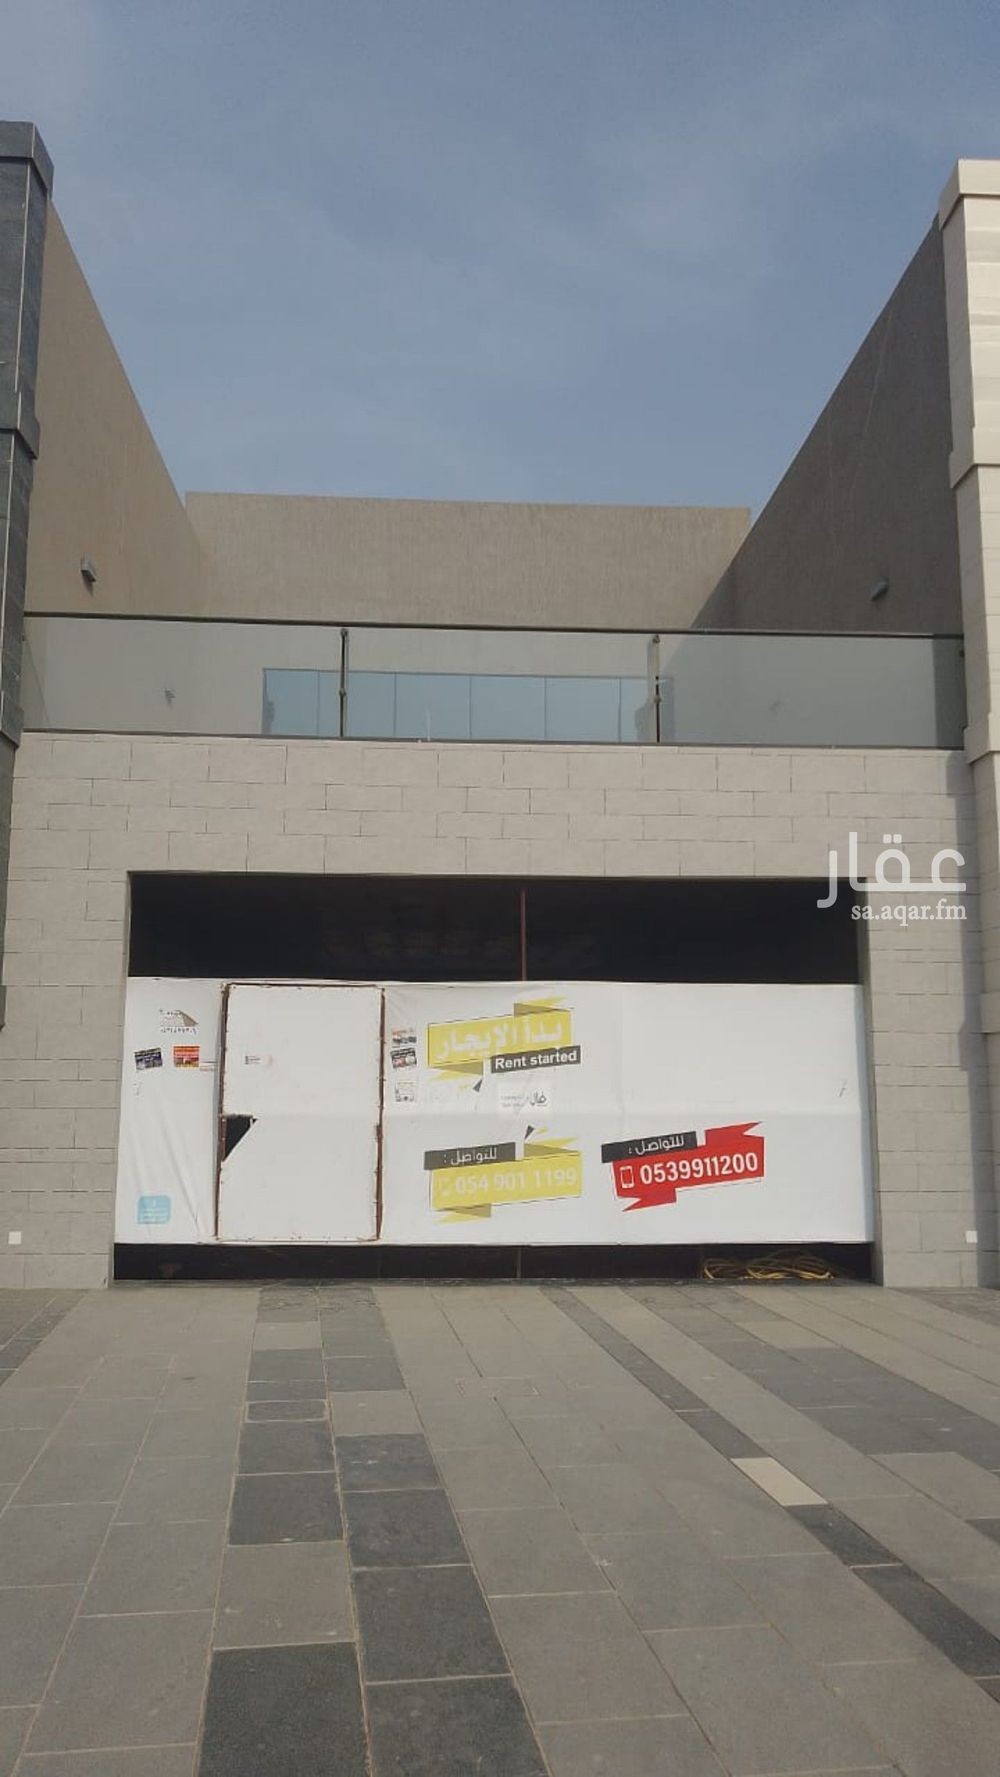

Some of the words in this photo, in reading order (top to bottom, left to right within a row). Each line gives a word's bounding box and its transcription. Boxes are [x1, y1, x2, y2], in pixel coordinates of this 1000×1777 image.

[495, 1056, 527, 1071] Rent
[530, 1049, 577, 1067] started
[635, 1135, 685, 1155] للتواصل
[450, 1147, 497, 1166] للتواصل
[640, 1153, 758, 1184] 0539911200
[455, 1174, 489, 1194] 054
[494, 1171, 526, 1190] 901
[533, 1167, 577, 1187] 1199
